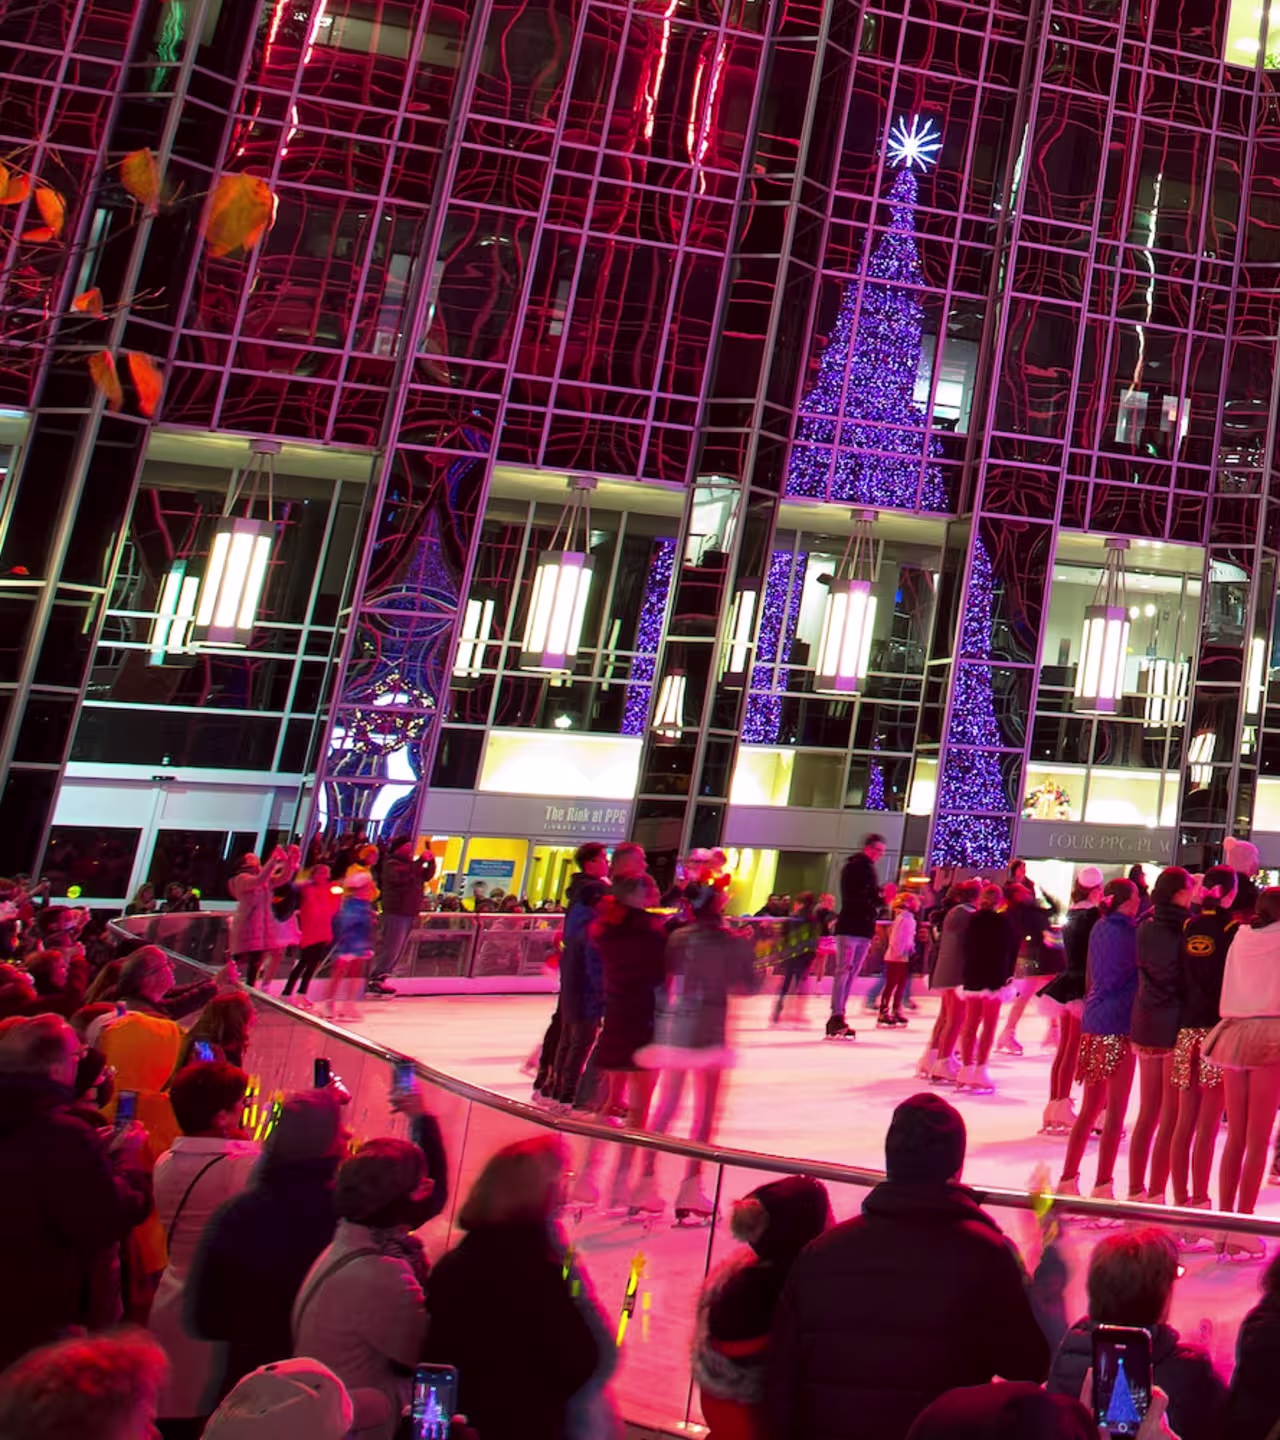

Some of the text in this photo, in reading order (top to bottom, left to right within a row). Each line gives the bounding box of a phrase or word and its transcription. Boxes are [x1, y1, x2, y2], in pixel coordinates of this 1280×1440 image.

[545, 806, 565, 822] The
[604, 808, 627, 825] PPG
[1048, 832, 1094, 849] FOUR
[1136, 836, 1171, 853] PLAC
